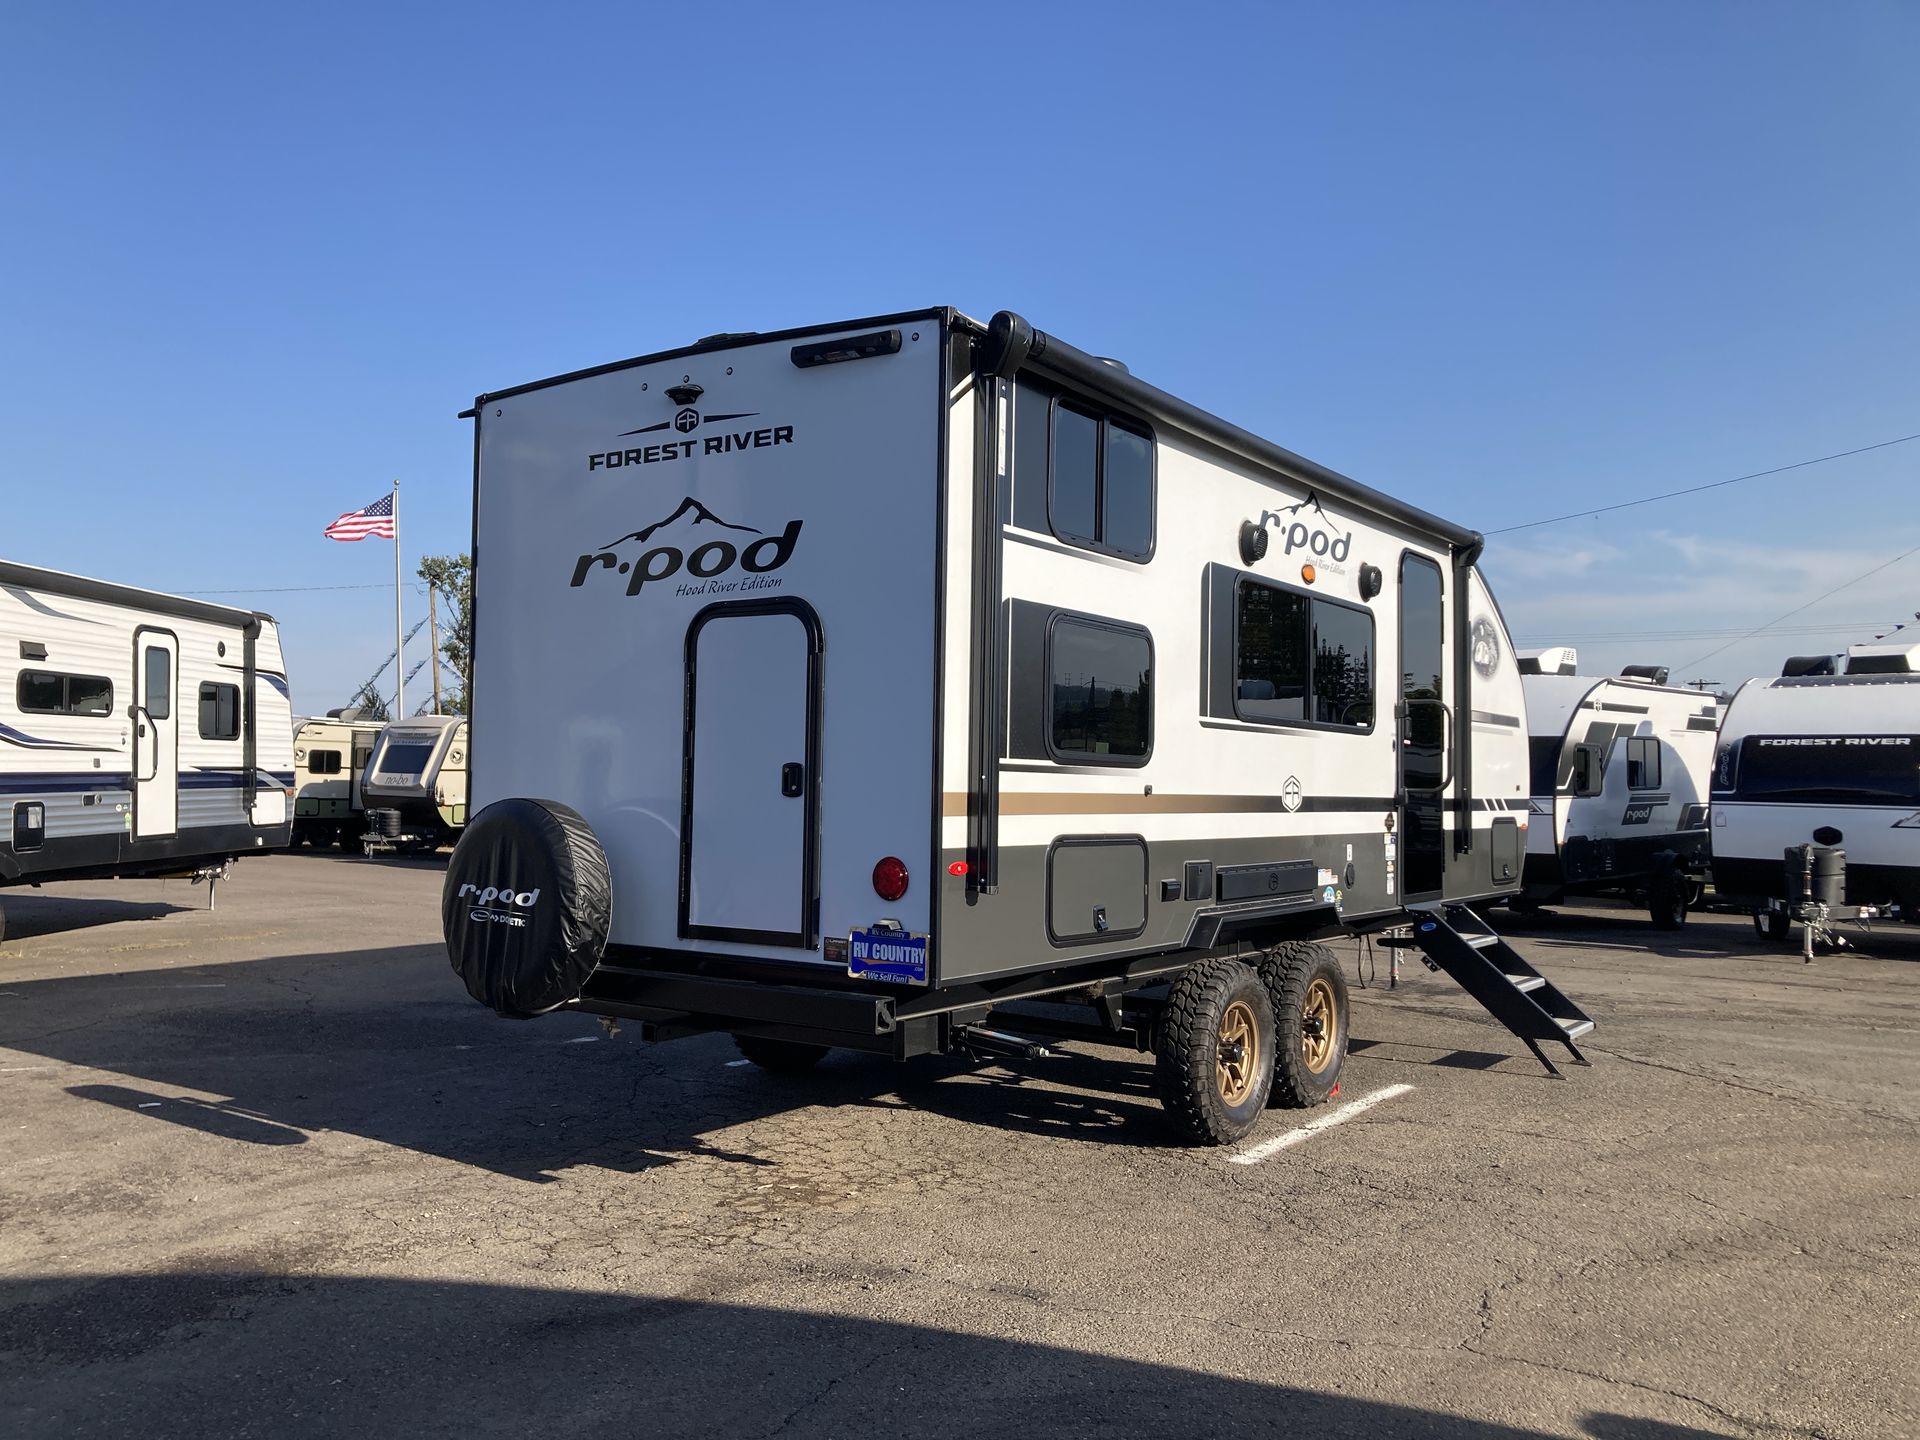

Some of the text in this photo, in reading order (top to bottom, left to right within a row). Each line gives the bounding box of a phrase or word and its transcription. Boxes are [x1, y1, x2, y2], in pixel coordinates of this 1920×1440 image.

[589, 425, 793, 471] FOREST RIVER
[676, 574, 782, 597] Hood River Edition
[1759, 737, 1911, 746] FOREST RIVER
[880, 929, 905, 939] Country
[853, 941, 869, 958] RV
[872, 943, 925, 964] COUNTRY
[867, 971, 908, 983] We Sell Fun!
